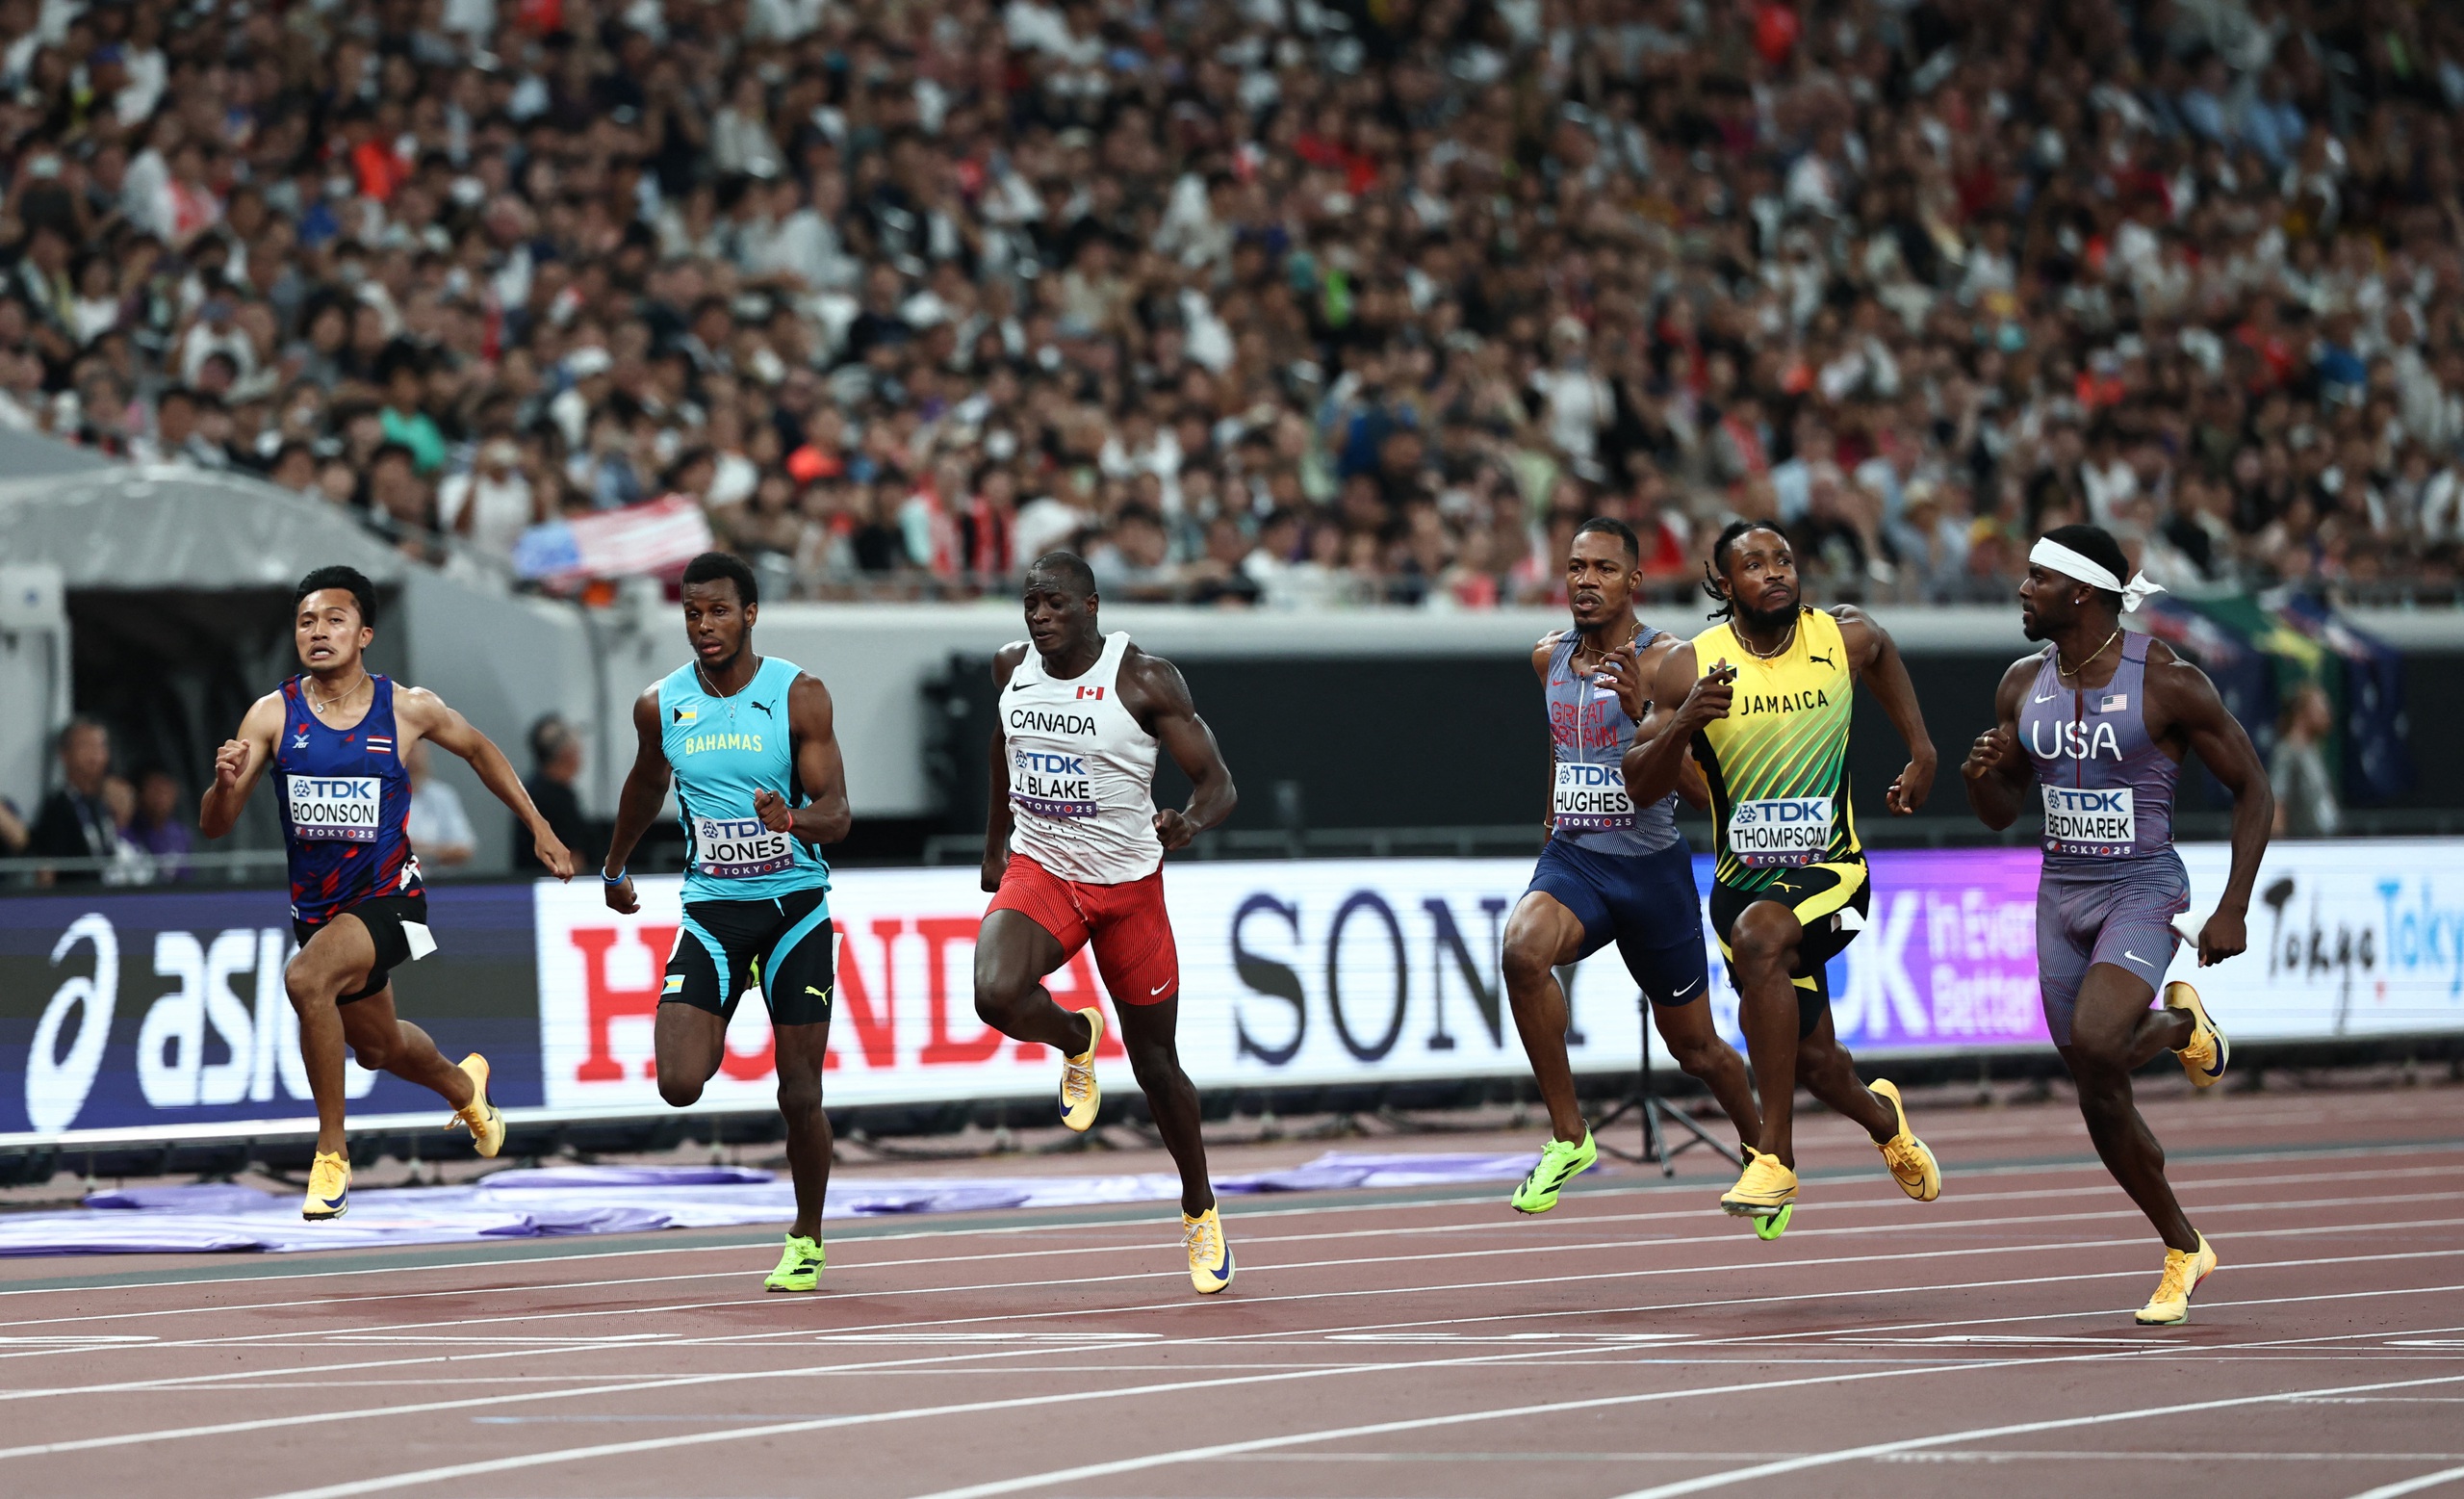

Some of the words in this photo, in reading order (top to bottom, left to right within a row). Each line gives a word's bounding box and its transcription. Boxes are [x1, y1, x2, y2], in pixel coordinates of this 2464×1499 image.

[1552, 700, 1607, 726] GREAT
[1741, 689, 1829, 715] JAMAICA
[1011, 710, 1096, 736] CANADA
[685, 733, 762, 755] BAHAMAS
[2033, 720, 2122, 761] USA
[1026, 753, 1086, 775] TDK
[1015, 773, 1025, 792] J.
[1028, 776, 1090, 799] BLAKE
[1570, 766, 1625, 787] TDK
[311, 781, 372, 799] TDK
[293, 802, 374, 823] BOONSON
[1555, 791, 1629, 812] HUGHES
[1756, 801, 1824, 822] TDK
[2059, 791, 2124, 812] TDK
[2048, 814, 2129, 839] BEDNAREK
[705, 836, 785, 862] JONES
[1733, 827, 1827, 849] THOMPSON
